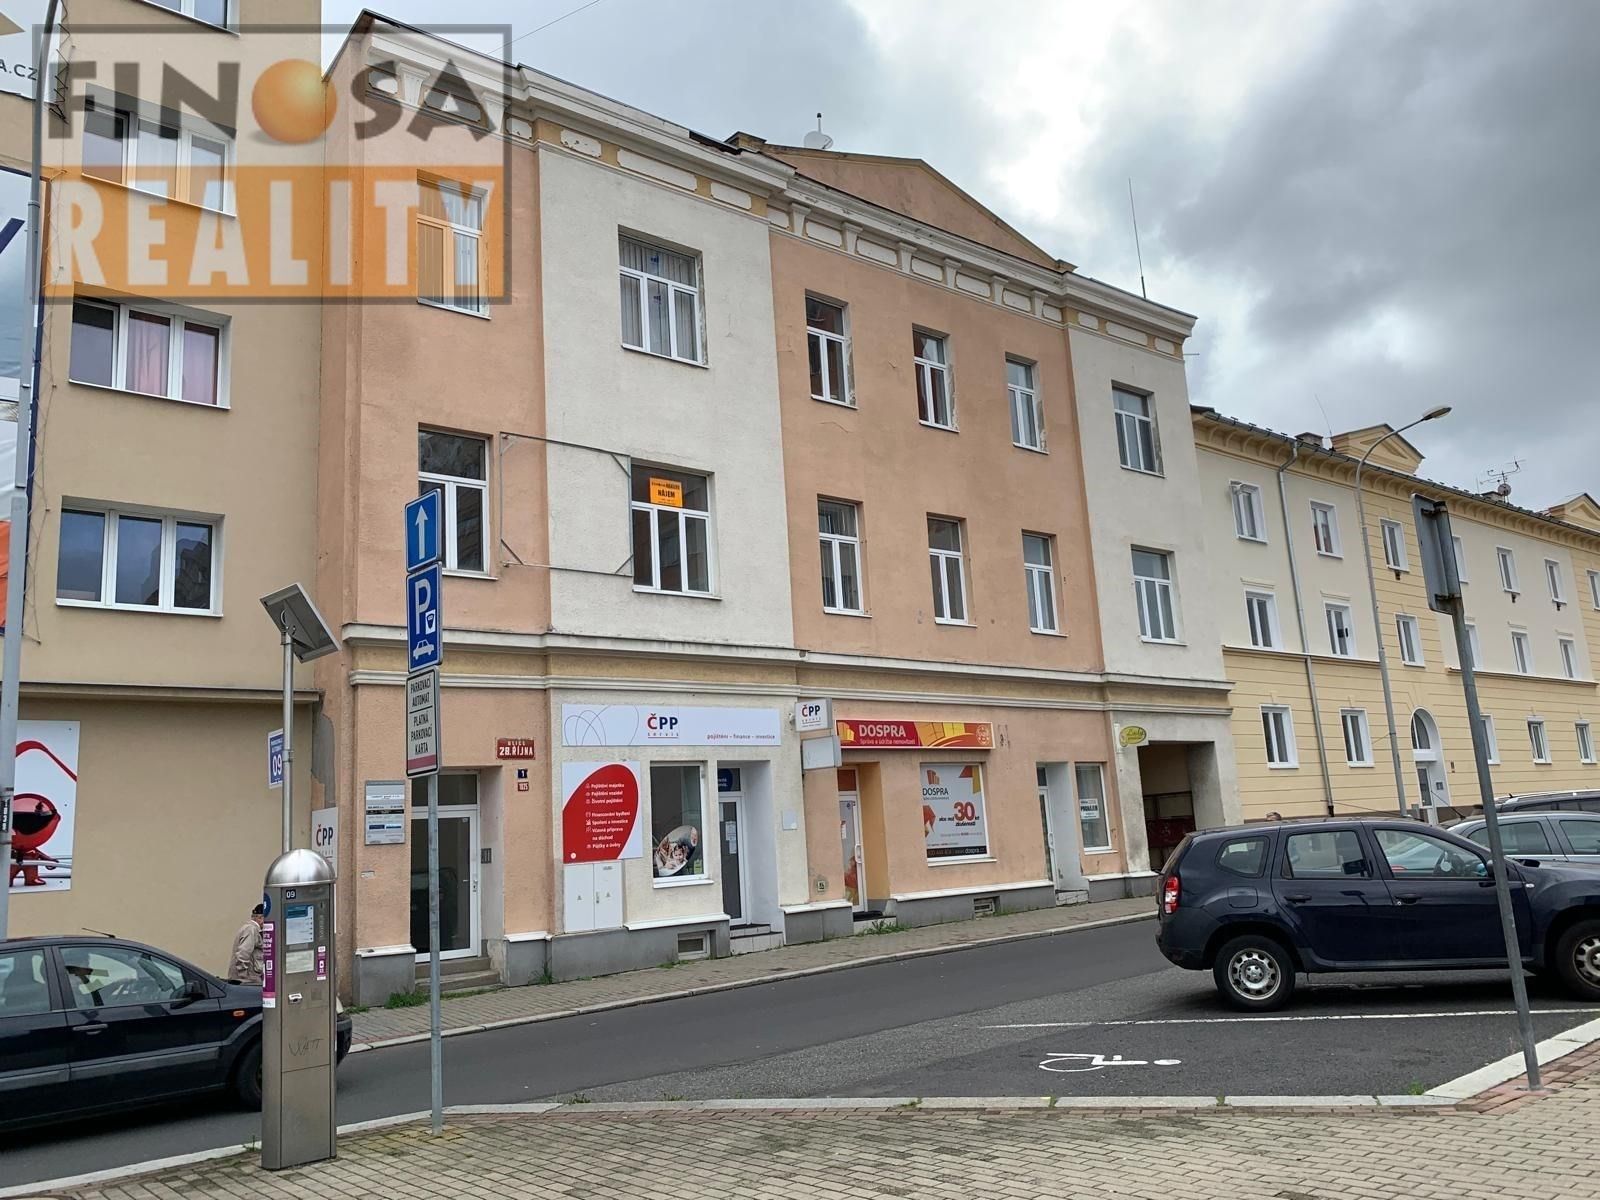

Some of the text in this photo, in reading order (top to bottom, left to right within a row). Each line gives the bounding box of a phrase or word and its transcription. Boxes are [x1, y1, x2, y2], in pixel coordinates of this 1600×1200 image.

[414, 578, 432, 635] P
[410, 675, 431, 694] PARKOVACÍ
[412, 692, 430, 707] AUTOMAT
[801, 704, 821, 717] ČPP
[413, 711, 429, 727] PLATNÁ
[647, 713, 679, 730] ČPP
[410, 724, 433, 741] PARKOVACÍ
[858, 724, 907, 737] DOSPRA
[414, 741, 429, 755] KARTA
[272, 753, 283, 776] 09
[922, 787, 949, 796] DOSPRA
[953, 801, 976, 822] 30
[315, 823, 334, 847] ČPP
[286, 890, 296, 899] 09
